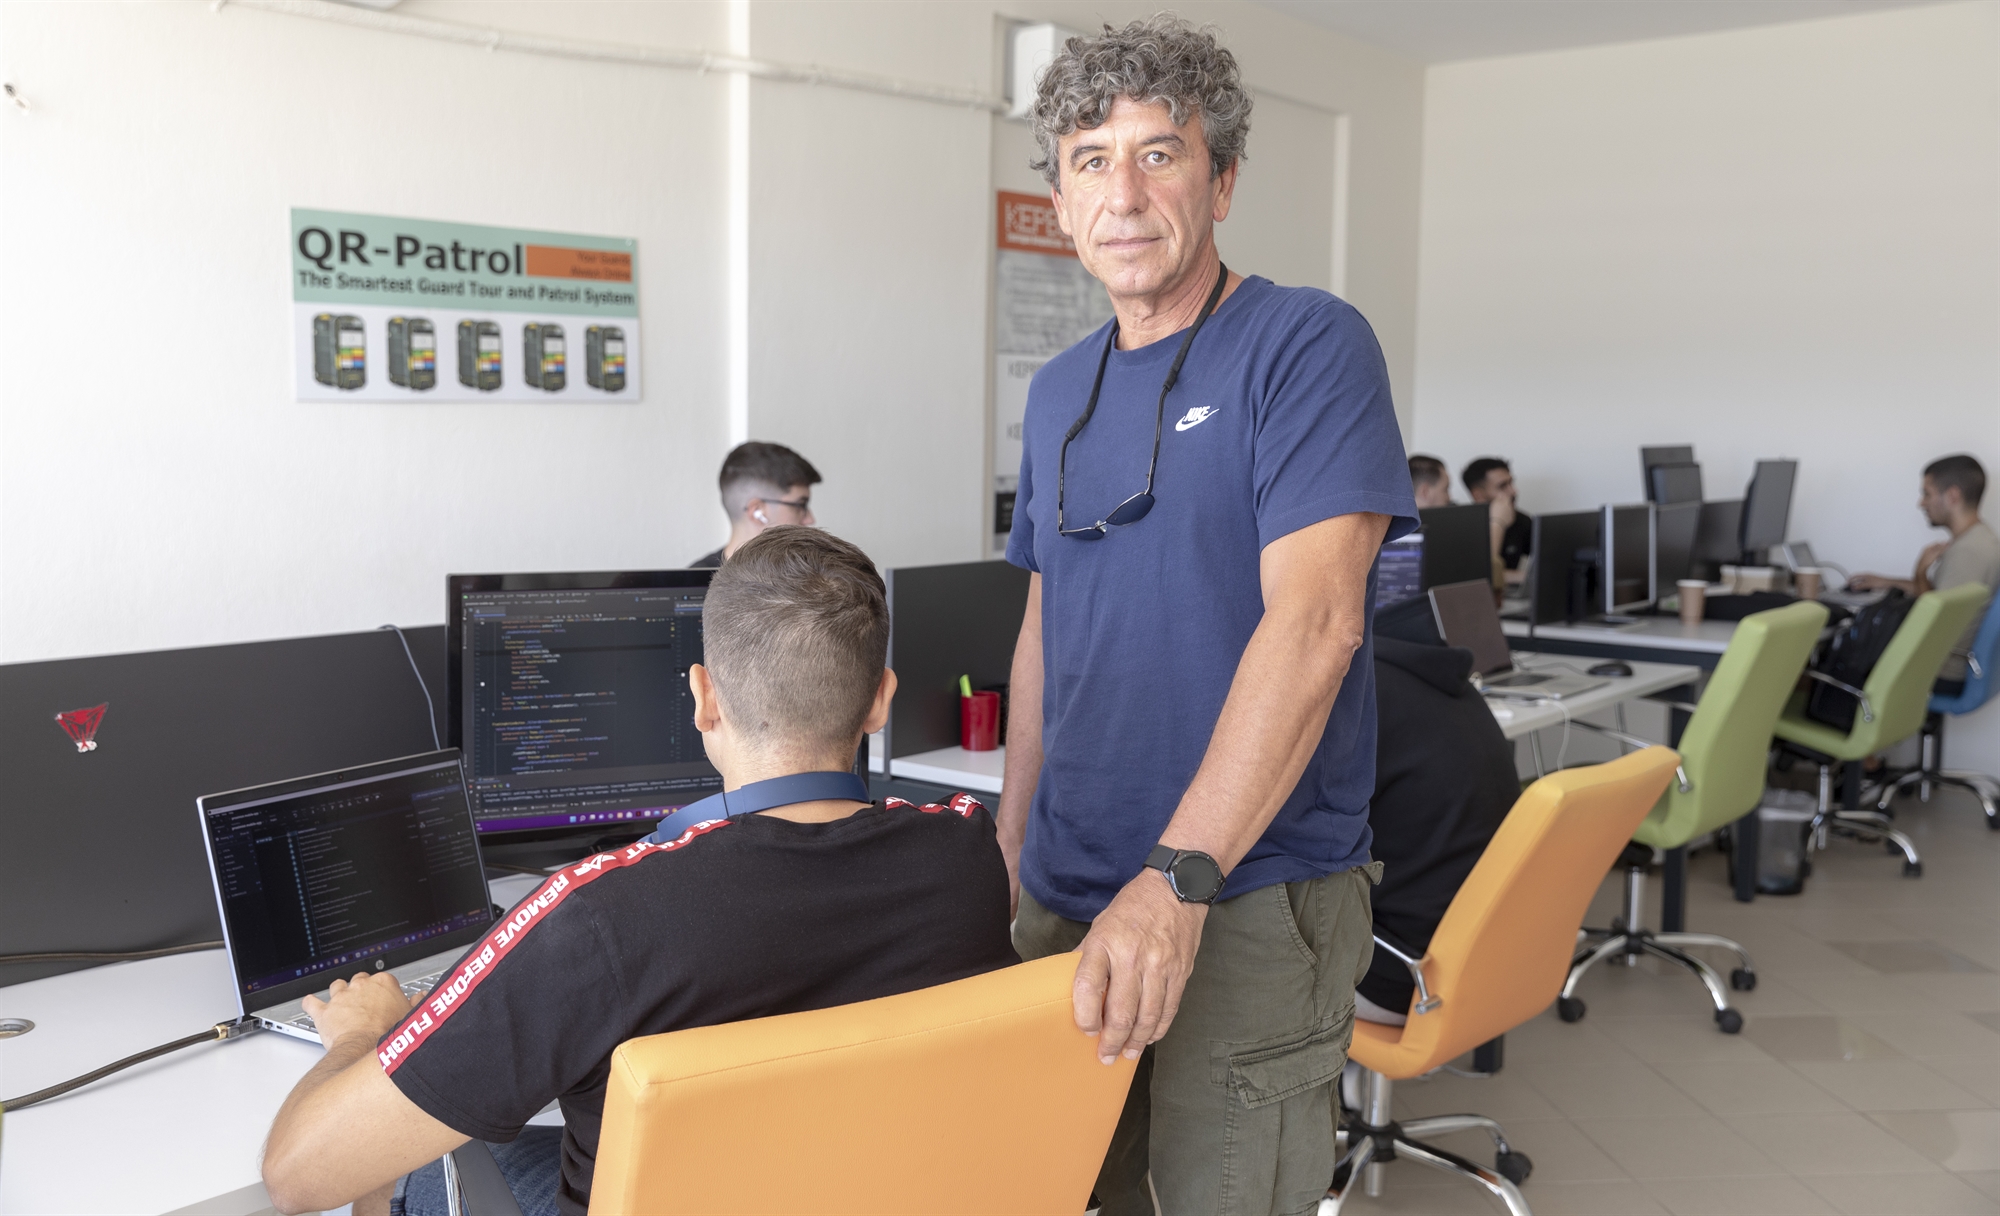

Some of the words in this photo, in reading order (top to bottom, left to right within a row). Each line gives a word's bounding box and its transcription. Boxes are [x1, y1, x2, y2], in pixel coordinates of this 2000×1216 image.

[298, 227, 522, 275] QR-Patrol
[299, 269, 332, 288] The
[336, 272, 415, 294] Smartest
[417, 278, 465, 297] Guard
[469, 280, 503, 297] Tour
[507, 283, 535, 300] and
[539, 284, 581, 303] Patrol
[584, 287, 635, 307] System
[494, 874, 569, 948] REMOVE
[430, 944, 495, 1016] BEFORE
[379, 1012, 433, 1070] FLIGH
